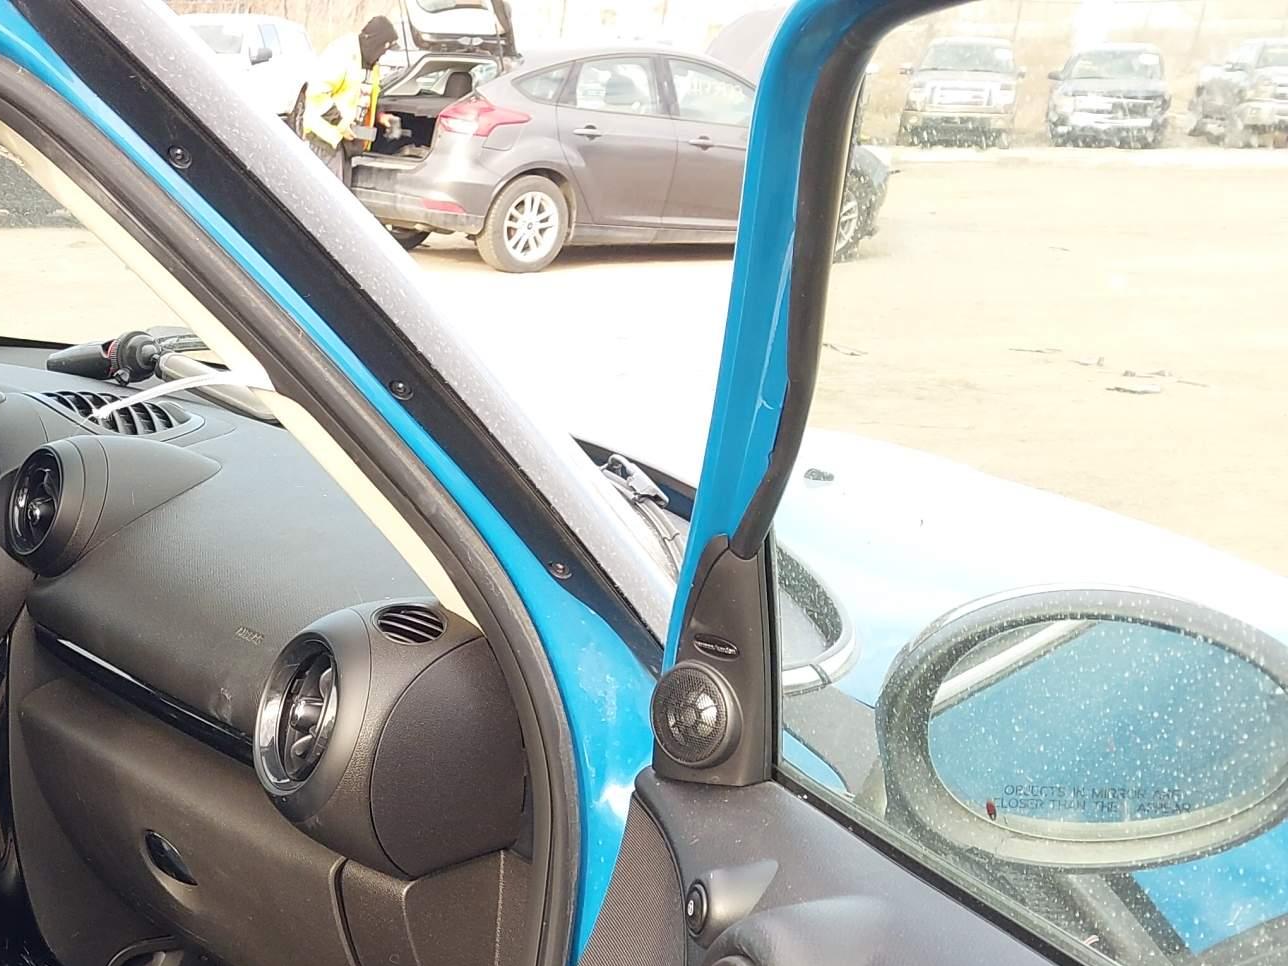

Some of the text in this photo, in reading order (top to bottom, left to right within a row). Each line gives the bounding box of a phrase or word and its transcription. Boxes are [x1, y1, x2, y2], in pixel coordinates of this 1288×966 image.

[1004, 784, 1066, 798] OBJECTS
[1092, 787, 1145, 800] MIRROR
[1050, 799, 1086, 811] THAN
